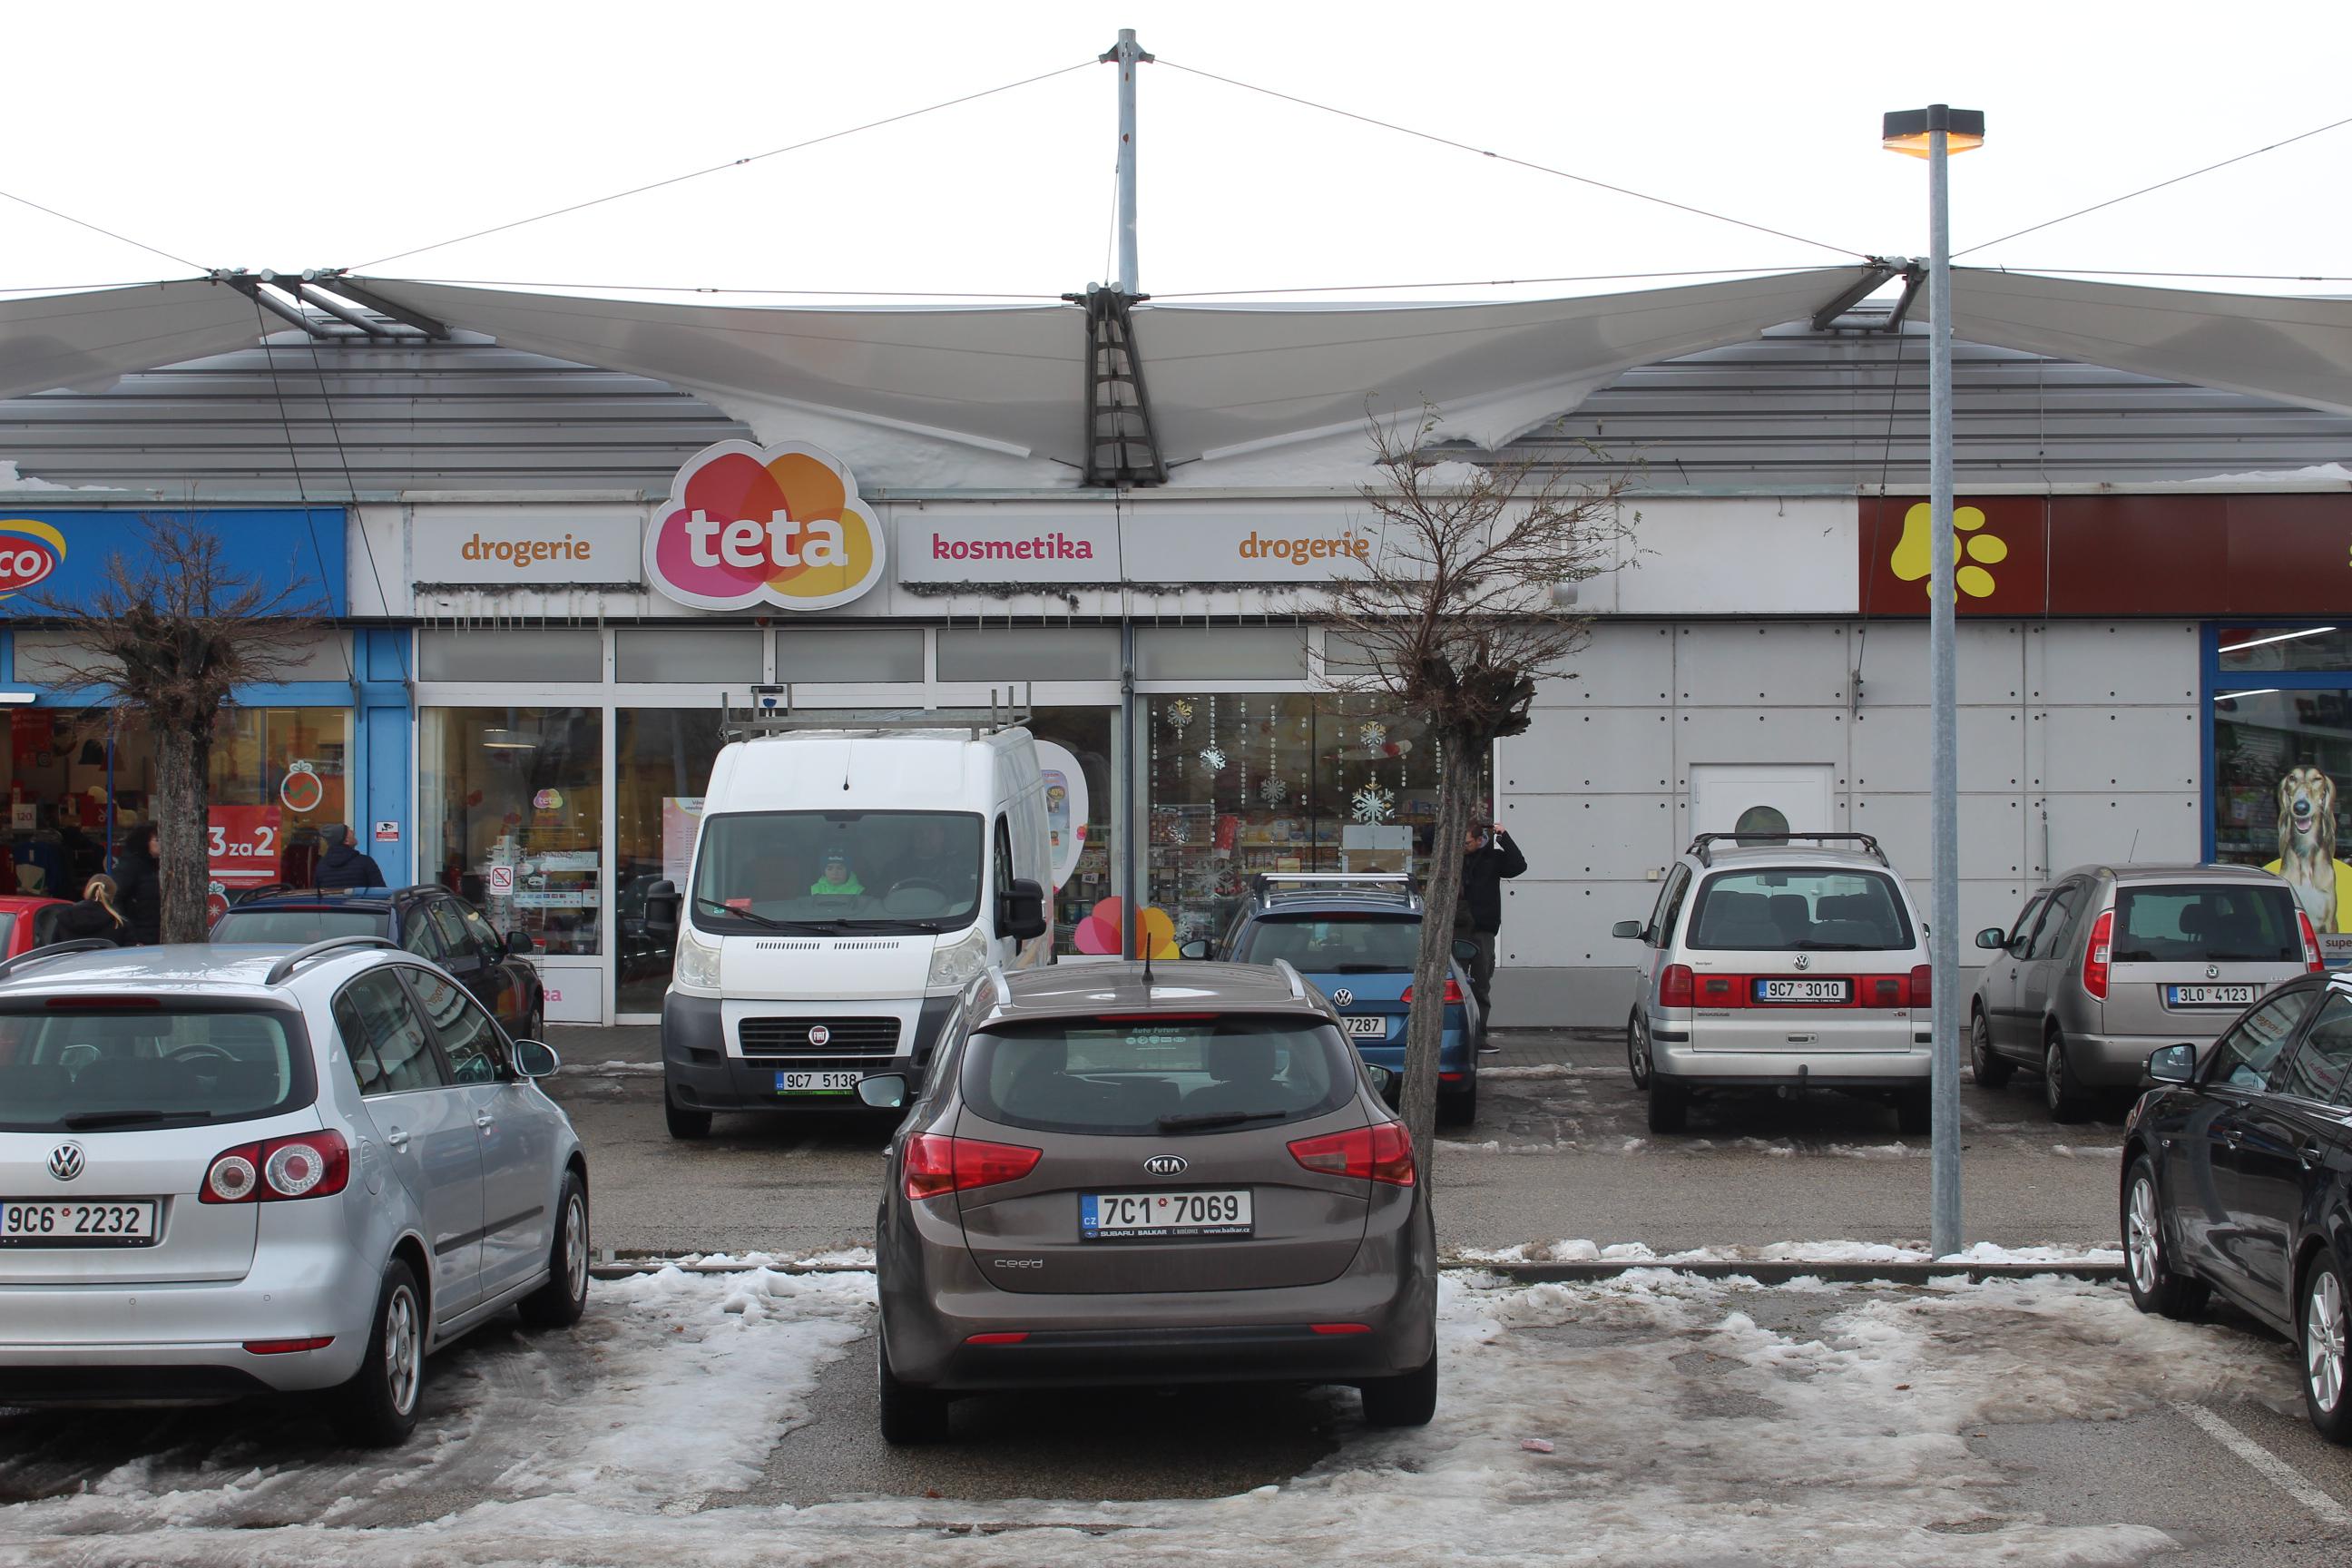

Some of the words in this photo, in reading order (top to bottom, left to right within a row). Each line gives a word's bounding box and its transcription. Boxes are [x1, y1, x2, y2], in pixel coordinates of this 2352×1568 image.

[685, 509, 848, 568] teta
[932, 533, 1093, 560] kosmetika
[1239, 532, 1370, 565] drogerie
[463, 534, 590, 567] drogerie
[208, 827, 227, 857] 3
[229, 843, 252, 857] za
[1769, 983, 1795, 996] 9C7
[1805, 983, 1839, 996] 3010
[2180, 988, 2205, 1002] 3L0
[2214, 988, 2248, 1002] 4123
[813, 1031, 826, 1041] FIAT
[1347, 1018, 1379, 1033] 7287
[787, 1073, 812, 1088] 9C7
[822, 1073, 857, 1088] 5138
[1152, 1160, 1181, 1172] KIA
[7, 1206, 55, 1233] 9C6
[74, 1206, 140, 1233] 2232
[1103, 1197, 1151, 1225] 7C1
[1173, 1195, 1239, 1222] 7069
[1083, 1217, 1097, 1225] CZ
